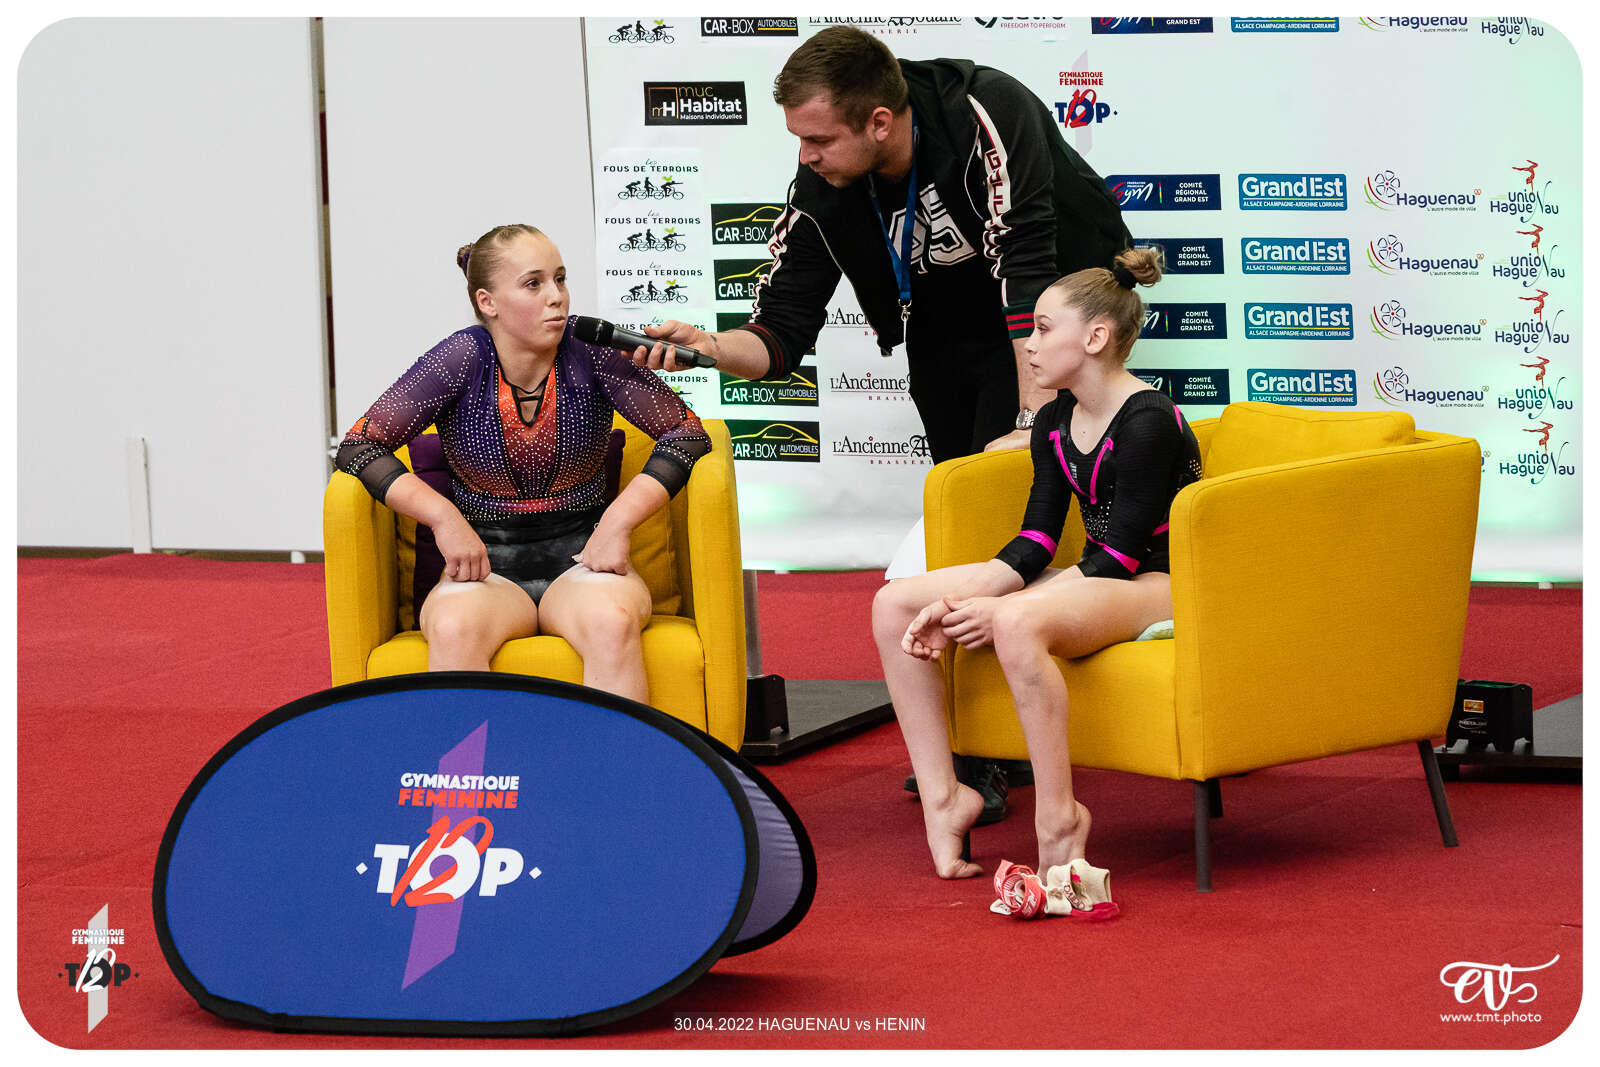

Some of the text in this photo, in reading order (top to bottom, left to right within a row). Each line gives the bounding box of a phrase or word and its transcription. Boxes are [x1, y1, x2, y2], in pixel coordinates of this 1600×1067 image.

[704, 19, 796, 34] CAR-BOX AUTOMOBILES
[1389, 17, 1468, 29] Haguenau
[679, 86, 713, 97] muc
[680, 97, 742, 112] Habitat
[1397, 193, 1476, 208] Haguenau
[715, 227, 767, 241] CAR-BOX
[1399, 258, 1479, 272] Haguenau
[718, 283, 760, 297] CAR-B
[1402, 323, 1481, 338] Haguenau
[830, 372, 906, 390] L'Ancienne
[723, 388, 817, 402] CAR-BOX AUTOMOBILES
[1405, 389, 1484, 404] Haguenau
[780, 445, 818, 453] AUTOMOBILES
[832, 436, 909, 454] L'Ancienne
[400, 773, 520, 790] GYMNASTIQUE
[398, 786, 518, 808] FÉMININE
